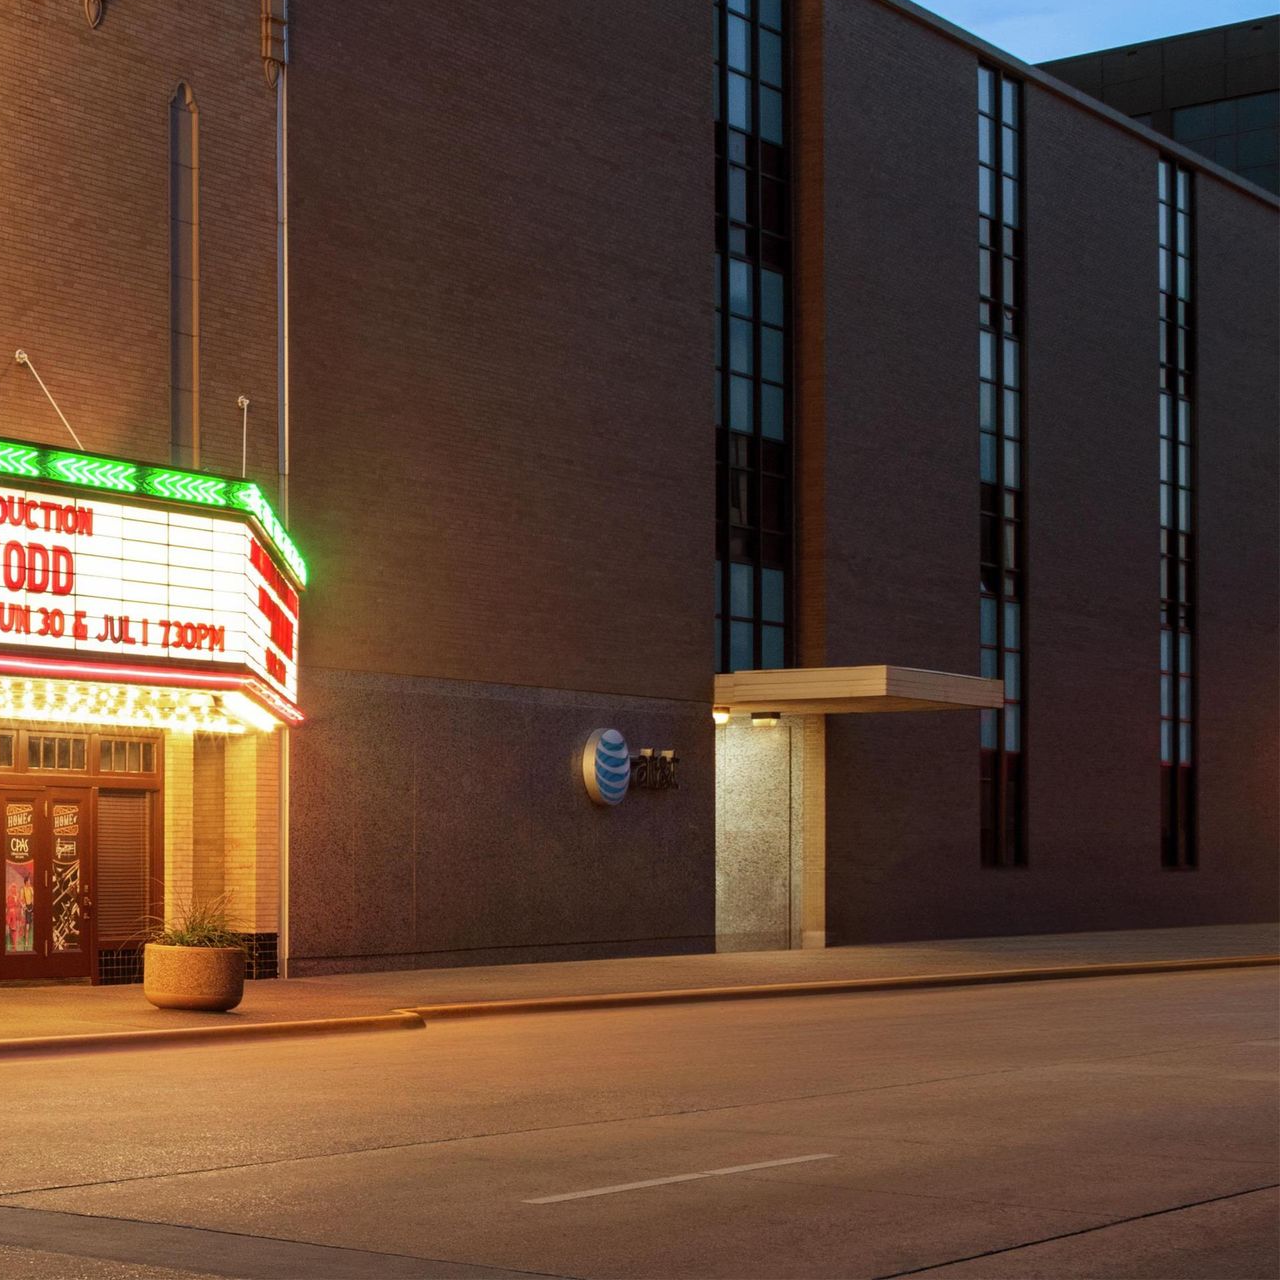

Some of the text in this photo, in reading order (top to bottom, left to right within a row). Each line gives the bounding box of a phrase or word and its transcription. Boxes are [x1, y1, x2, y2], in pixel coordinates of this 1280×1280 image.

[38, 608, 64, 638] 30
[73, 611, 87, 640] &
[98, 617, 135, 645] JUL
[160, 620, 224, 652] 730PM
[7, 812, 28, 827] HOME
[54, 813, 74, 828] HOME
[10, 837, 29, 853] CPAS
